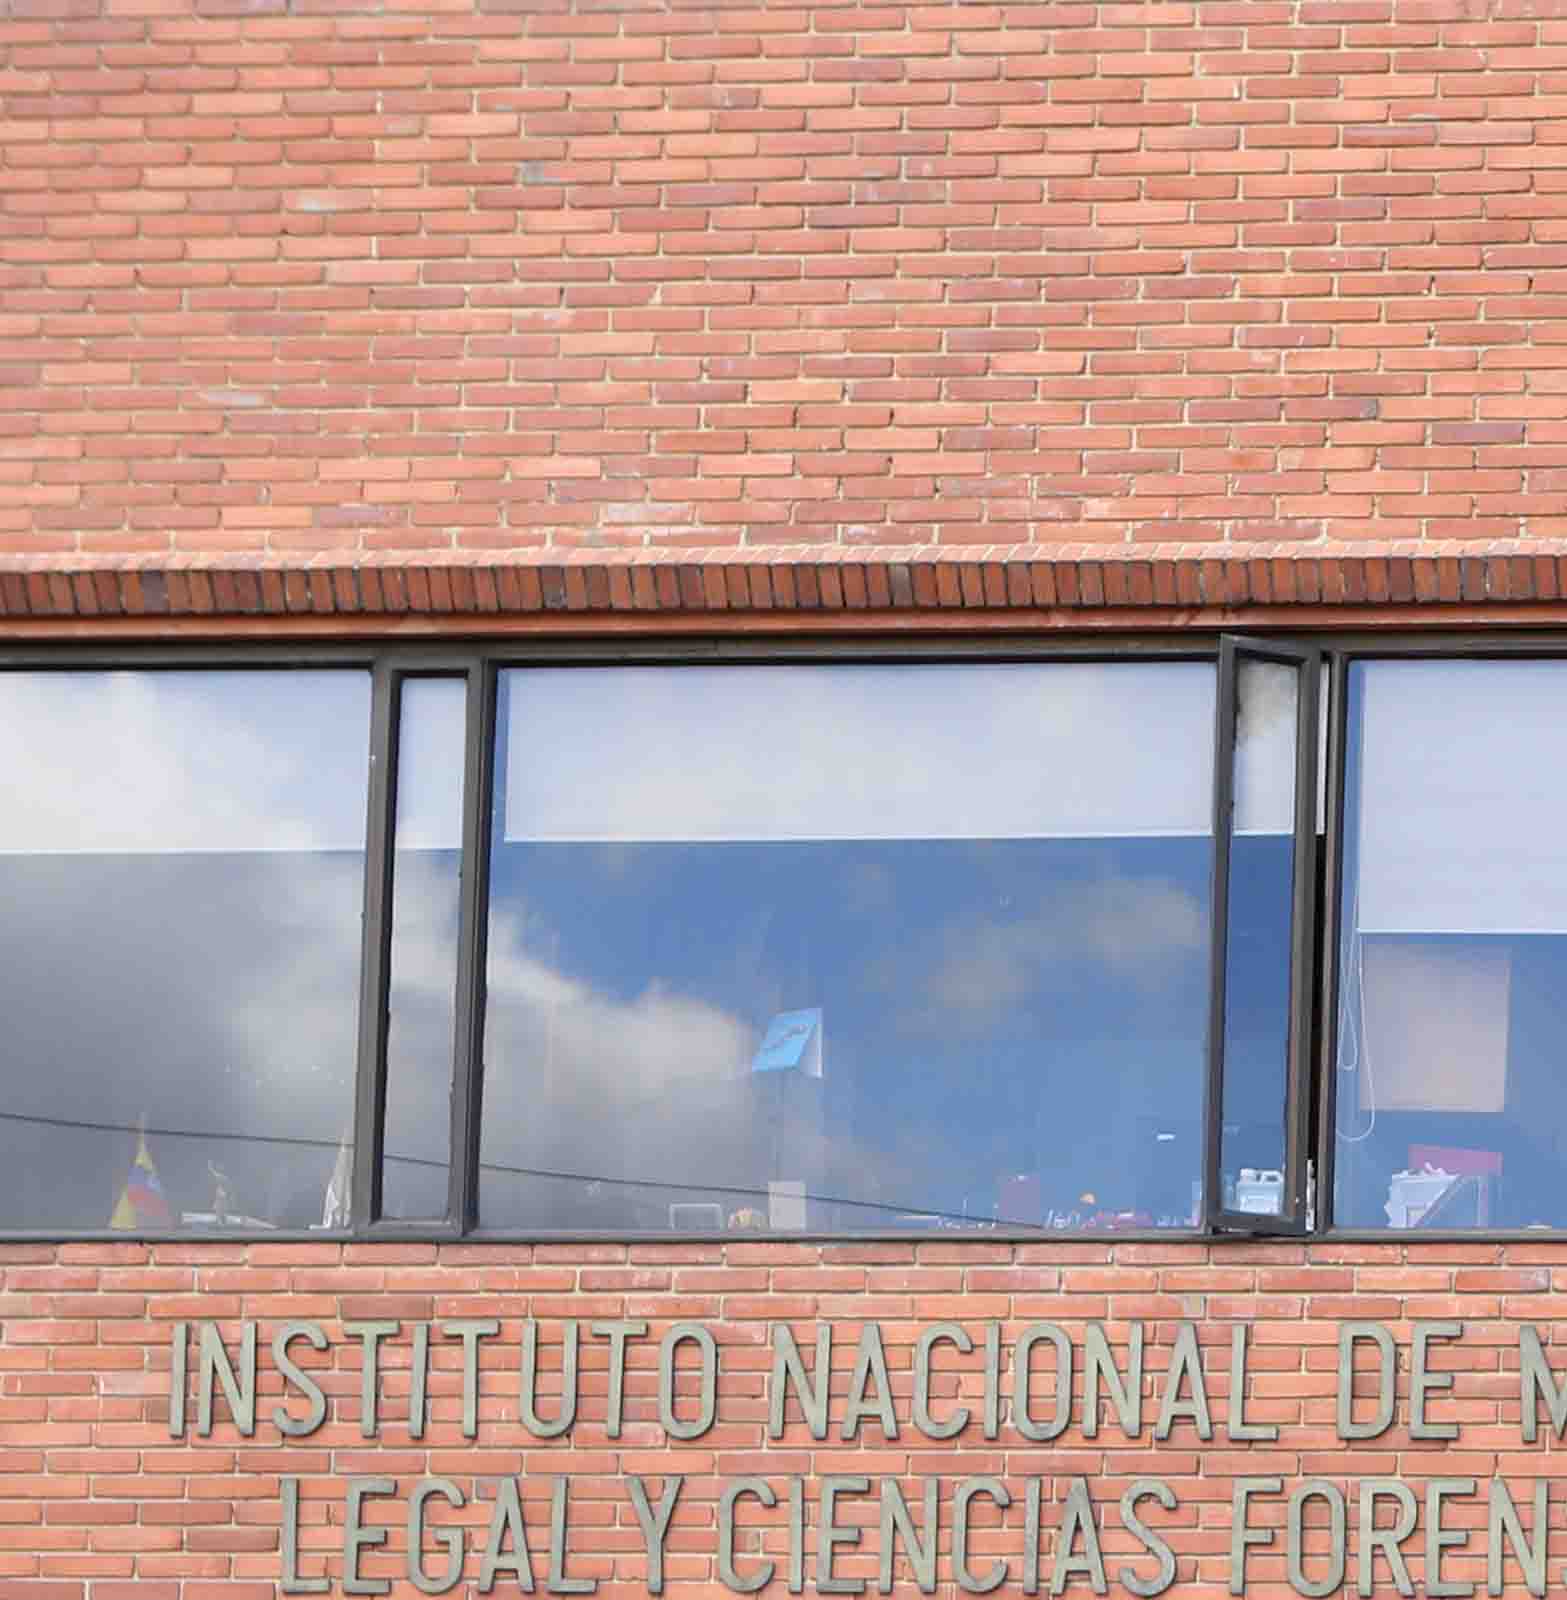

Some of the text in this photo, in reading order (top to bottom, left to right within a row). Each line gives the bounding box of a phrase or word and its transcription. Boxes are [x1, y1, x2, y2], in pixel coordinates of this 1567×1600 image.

[168, 1319, 719, 1442] INSTITUTO
[769, 1321, 1280, 1444] NACIONAL
[1337, 1321, 1463, 1442] DE
[278, 1475, 599, 1597] LEGAL
[625, 1475, 684, 1596] Y
[716, 1475, 1177, 1599] CIENCIAS
